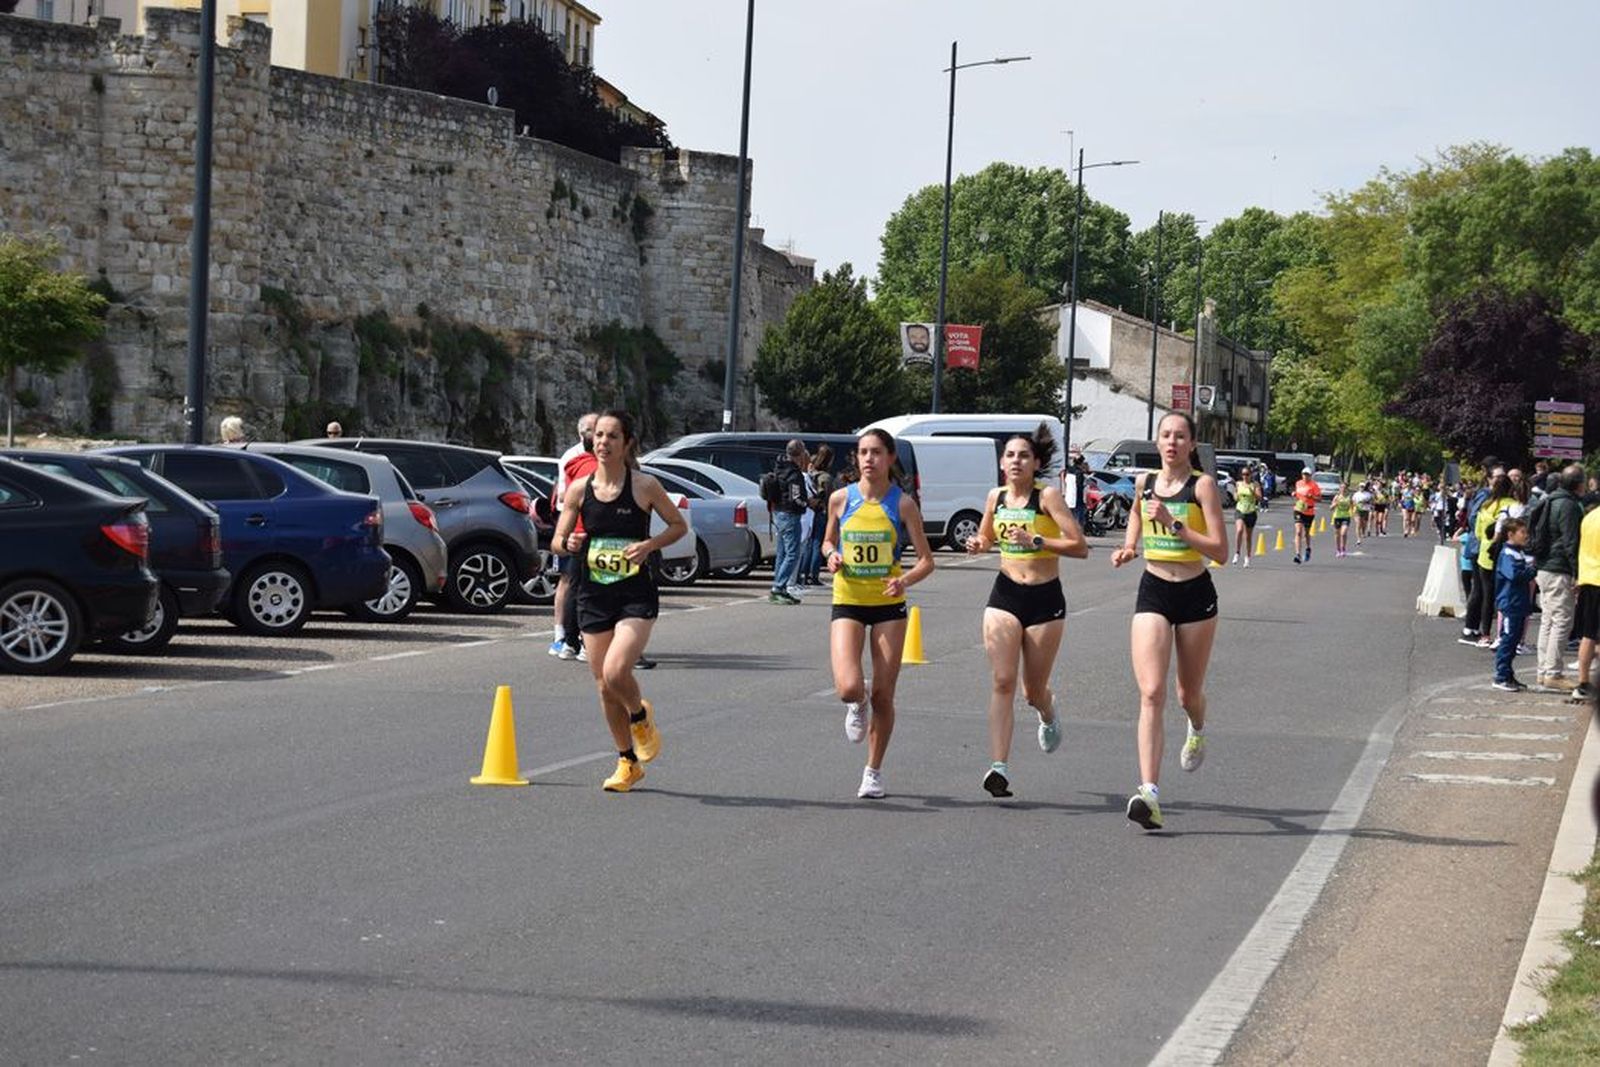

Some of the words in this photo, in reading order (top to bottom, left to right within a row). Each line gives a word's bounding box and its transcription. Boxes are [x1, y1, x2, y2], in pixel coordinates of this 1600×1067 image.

[1148, 519, 1178, 536] 11
[853, 545, 879, 563] 30
[595, 554, 631, 574] 651
